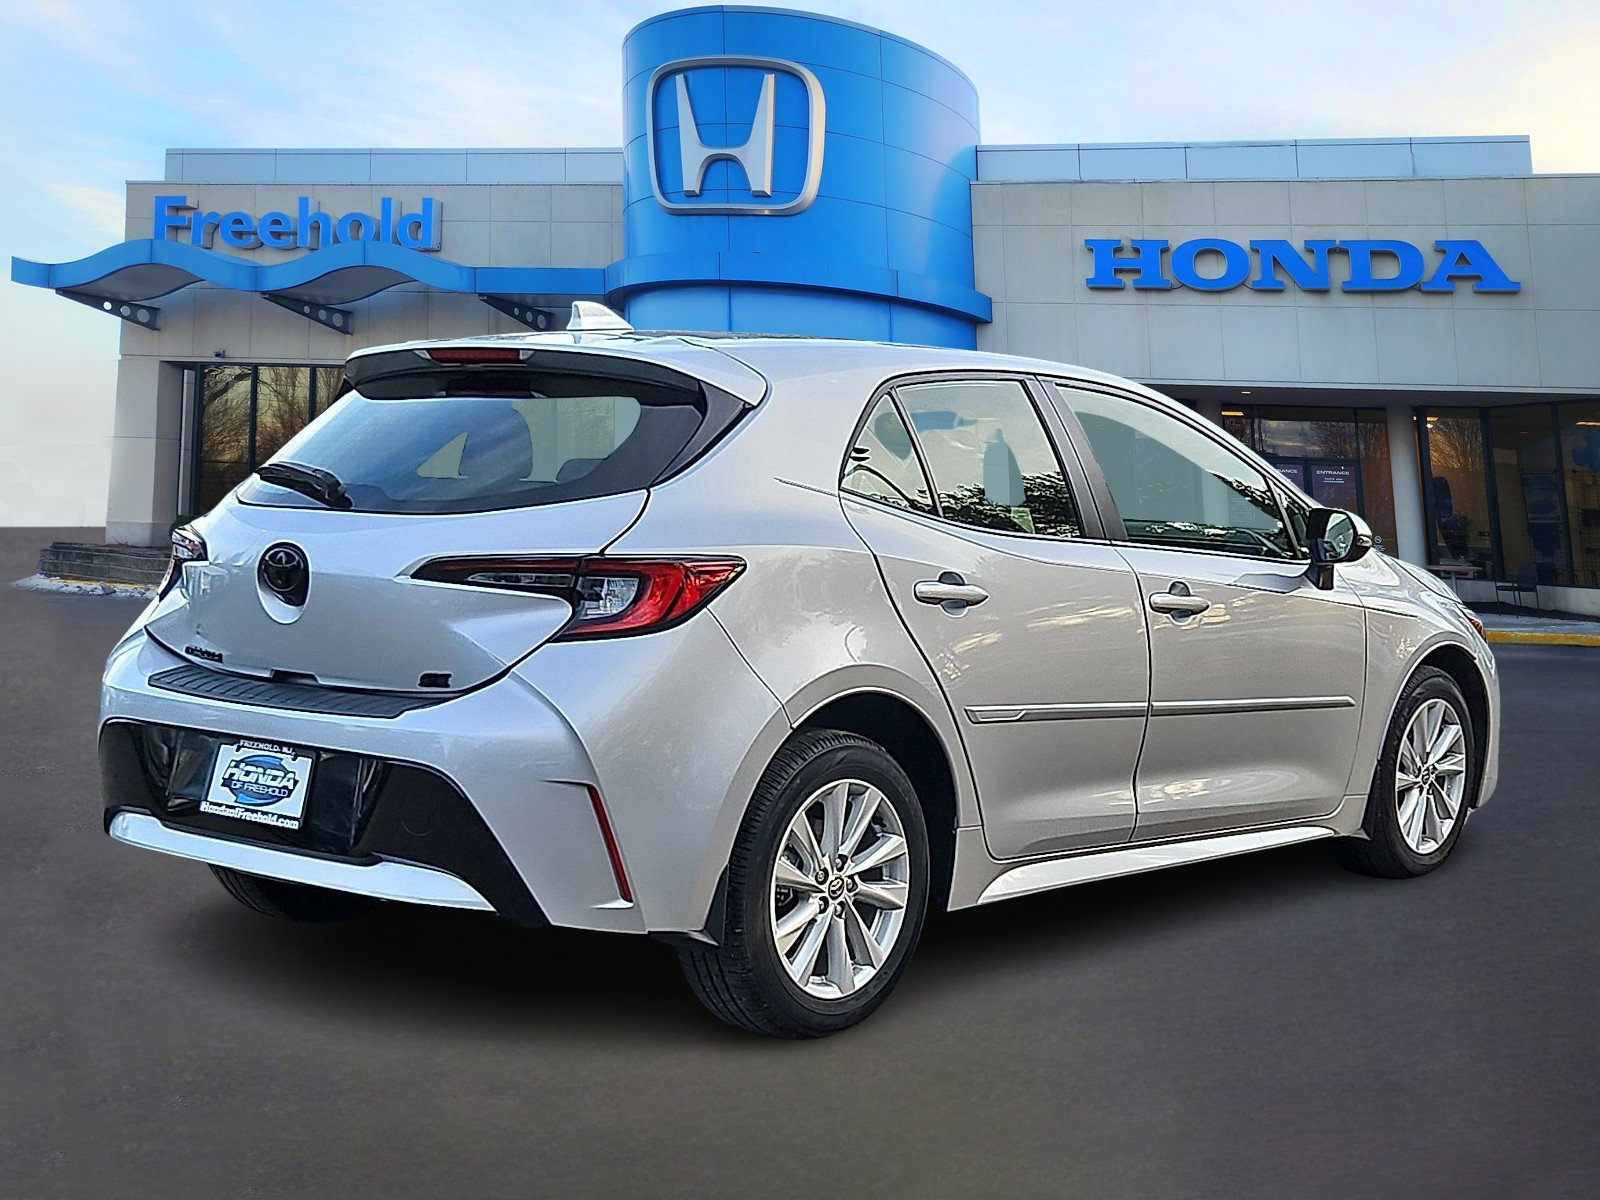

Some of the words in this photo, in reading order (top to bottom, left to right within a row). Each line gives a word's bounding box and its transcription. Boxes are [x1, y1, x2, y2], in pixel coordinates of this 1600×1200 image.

[153, 196, 442, 251] Freehold
[1084, 238, 1521, 293] HONDA
[223, 761, 297, 790] HONDA
[231, 781, 243, 790] OF
[244, 783, 289, 797] FREEHOLD
